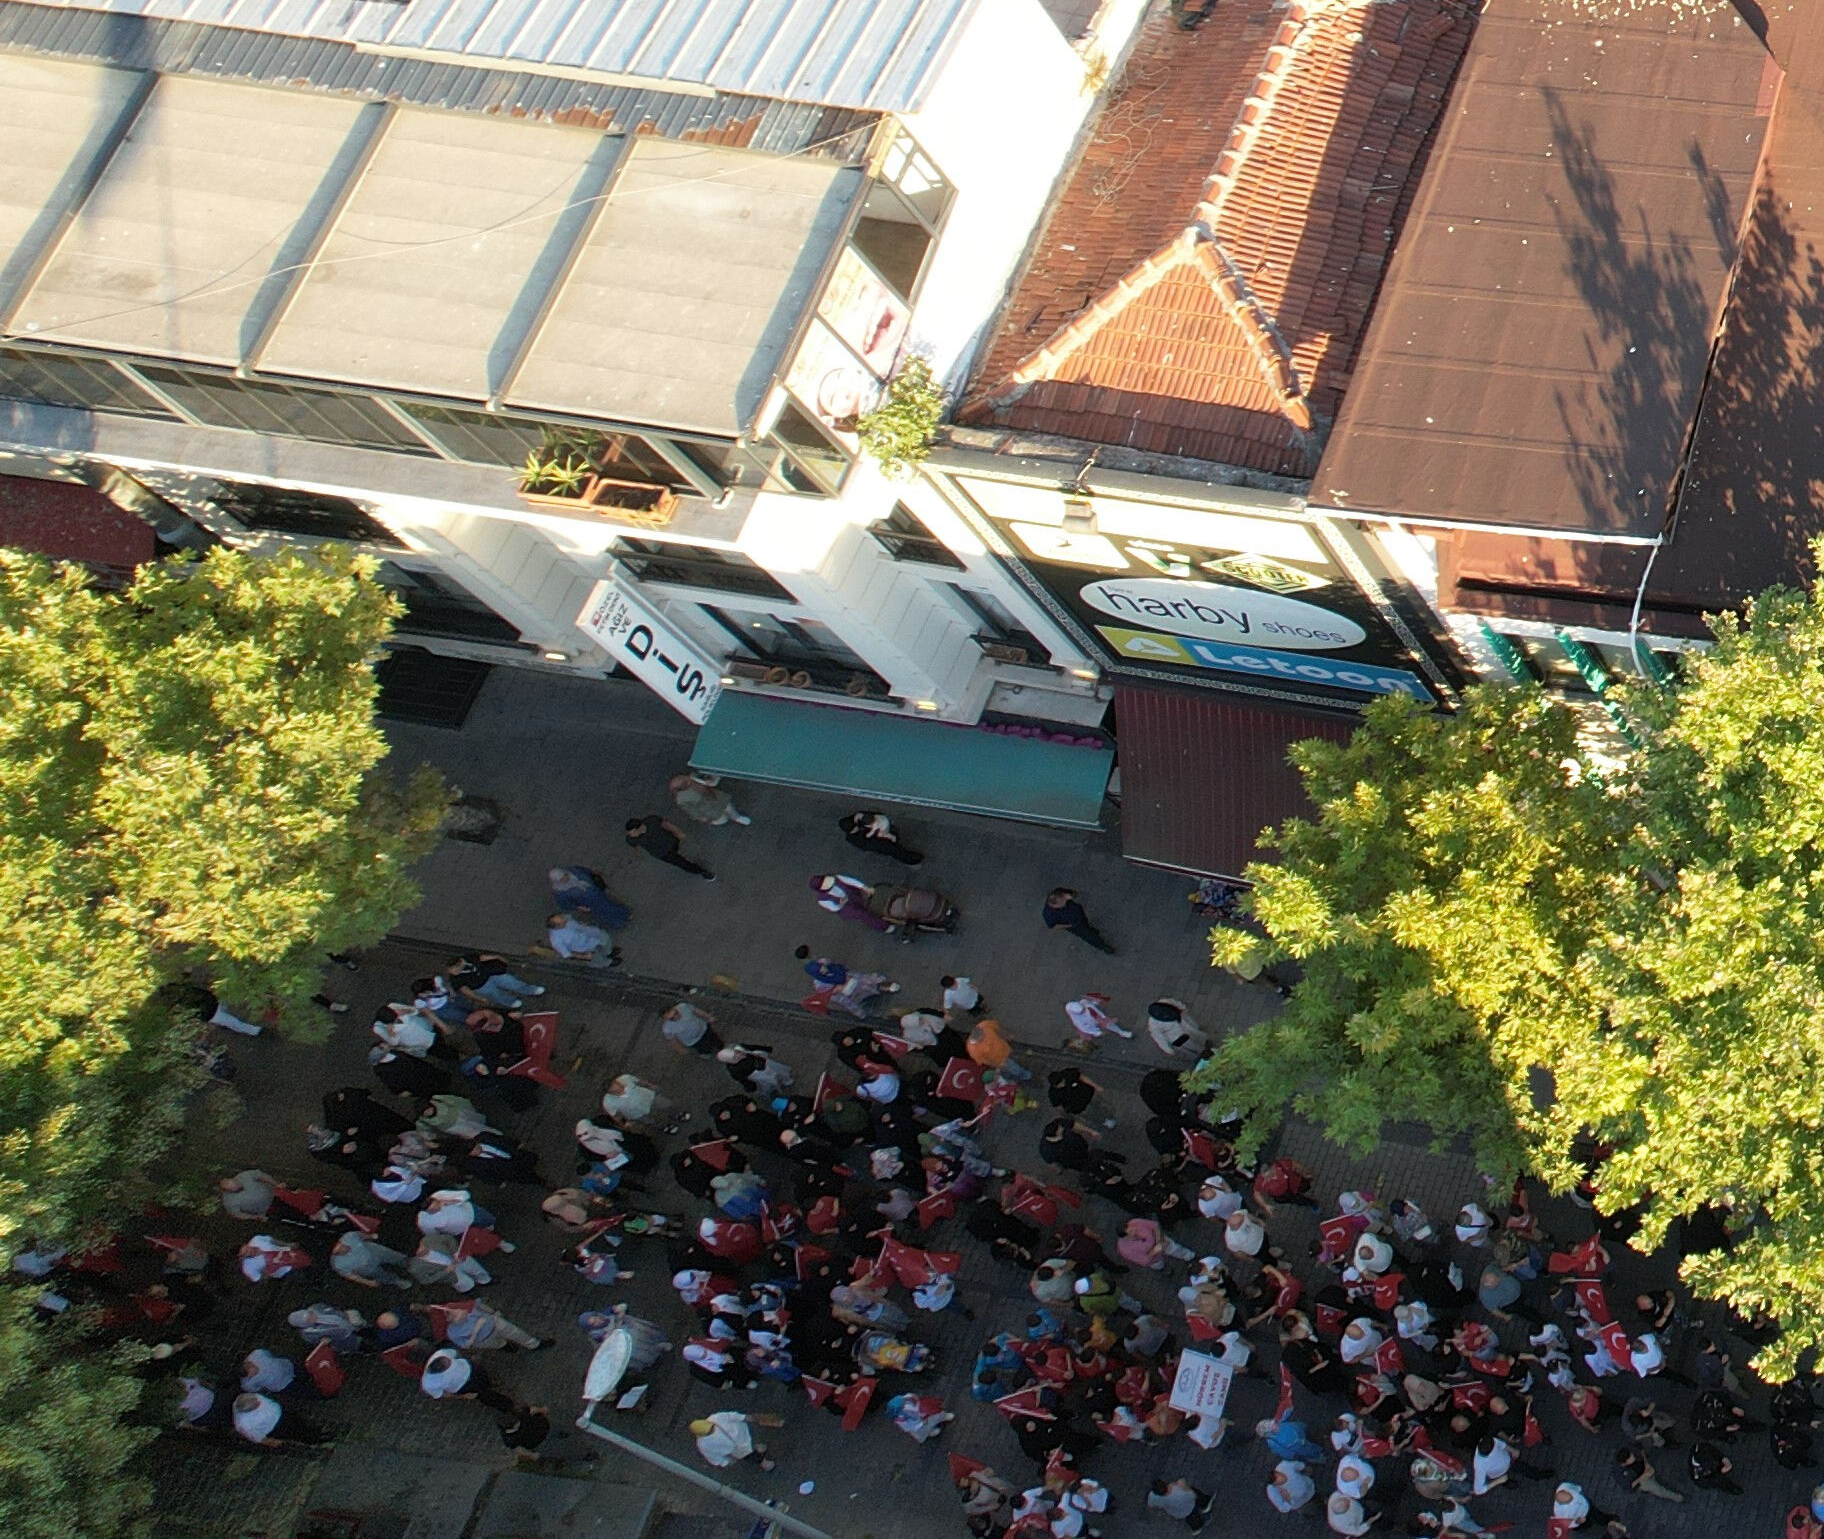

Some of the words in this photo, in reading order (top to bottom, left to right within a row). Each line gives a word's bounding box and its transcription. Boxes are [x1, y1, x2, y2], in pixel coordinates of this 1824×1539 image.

[1097, 585, 1251, 635] harby
[1261, 621, 1347, 644] shoes
[1193, 645, 1413, 694] Letoon
